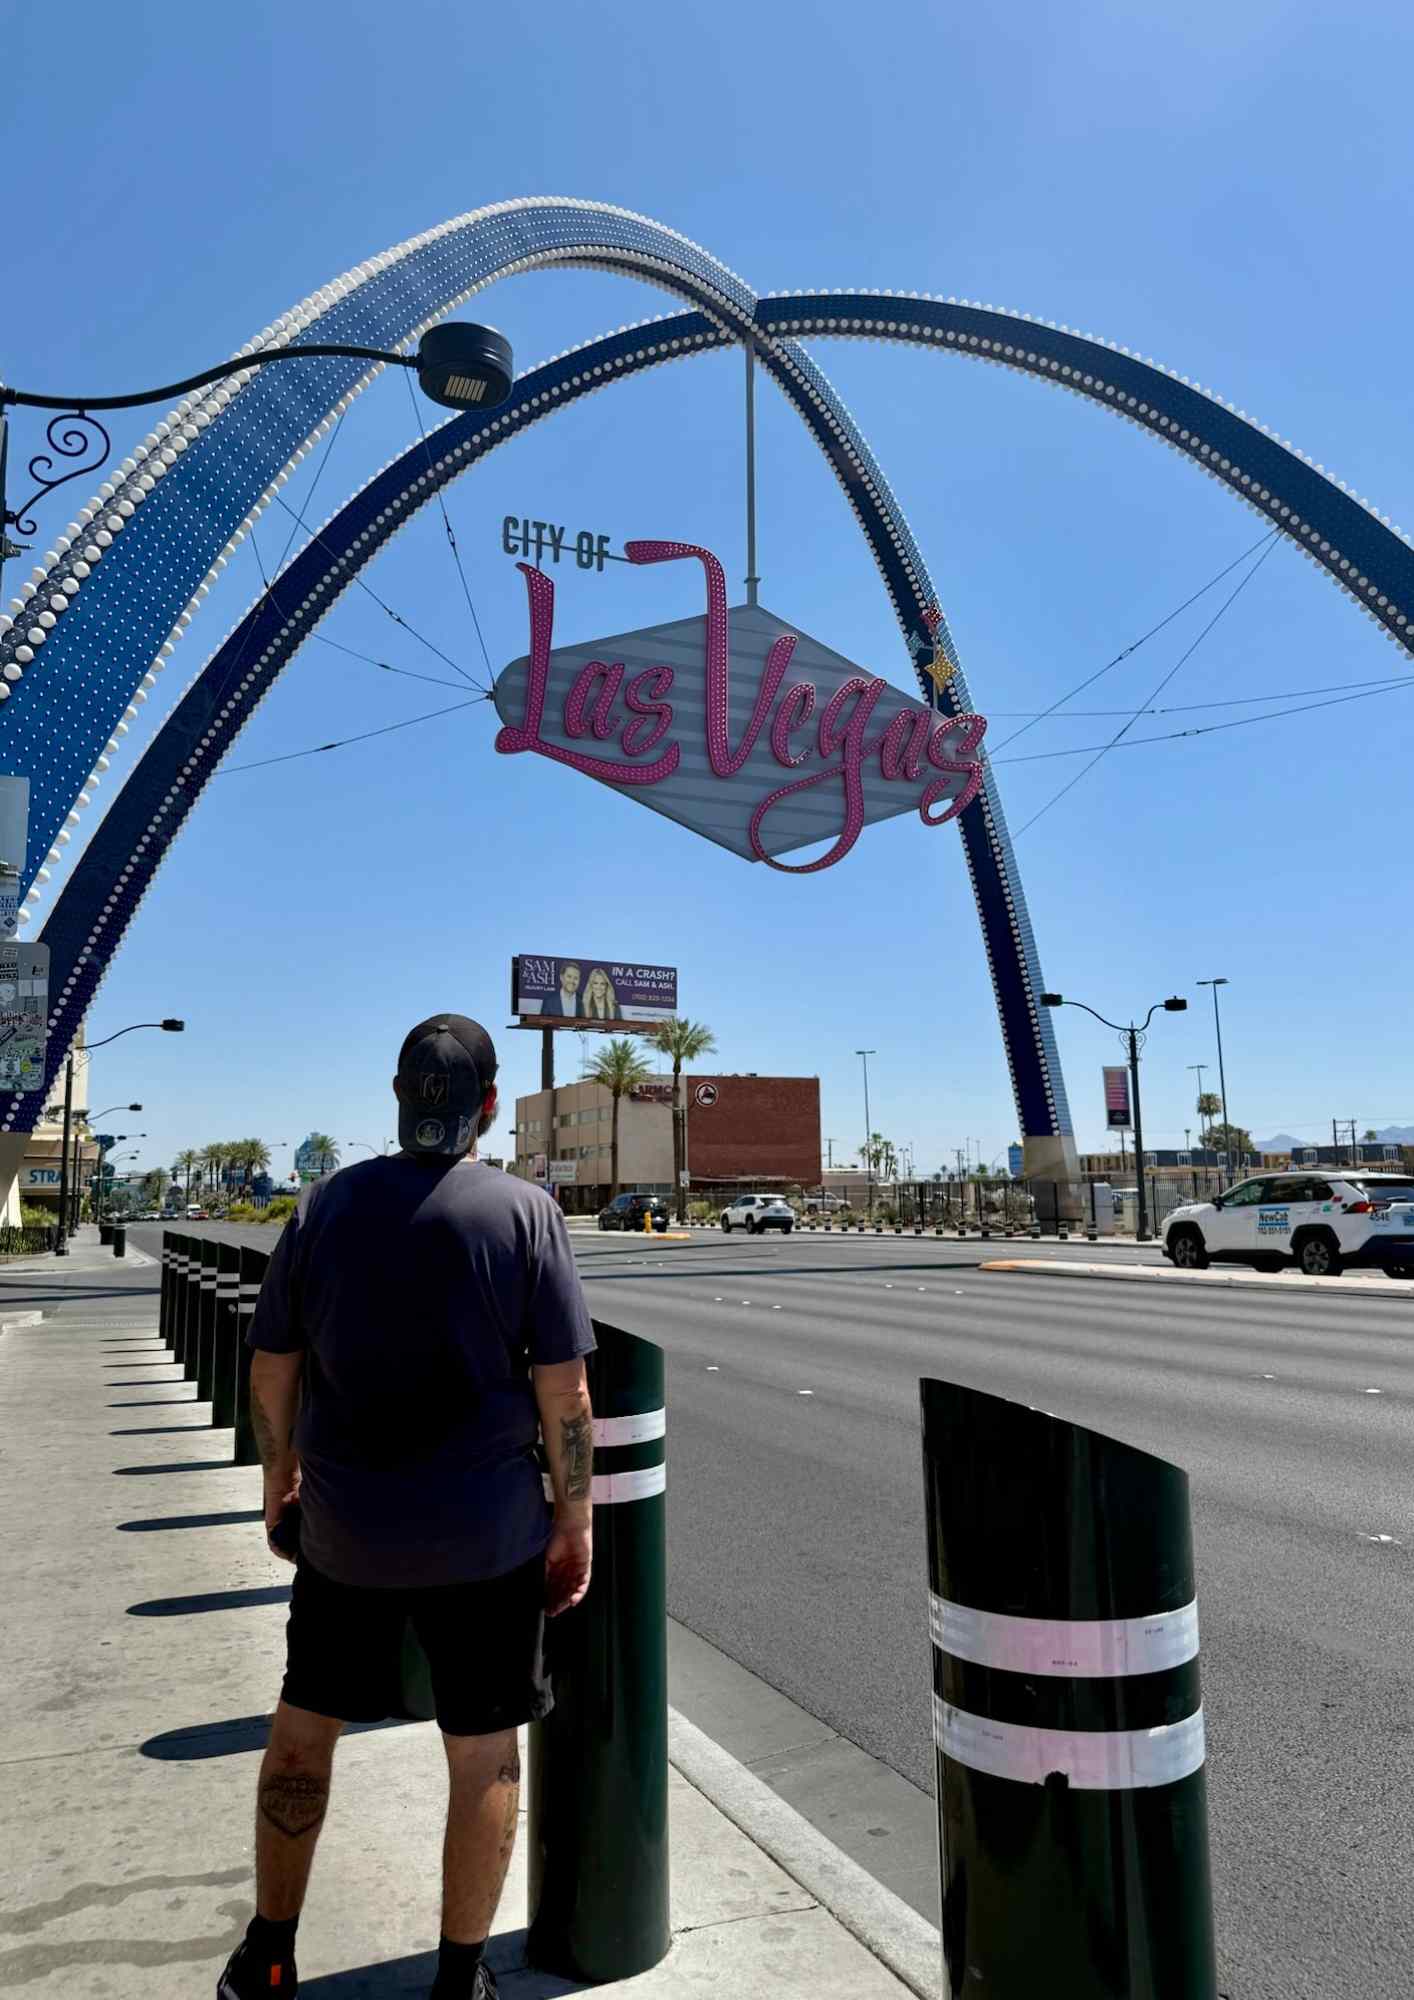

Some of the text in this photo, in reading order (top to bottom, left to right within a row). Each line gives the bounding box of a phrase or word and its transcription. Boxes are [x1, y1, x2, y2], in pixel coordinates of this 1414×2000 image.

[503, 515, 610, 572] CITY OF
[495, 540, 988, 874] Las Vegas
[525, 959, 555, 972] SAM
[527, 971, 555, 985] ASH
[611, 966, 676, 981] IN A CRASH?
[1259, 1210, 1289, 1222] NewCab
